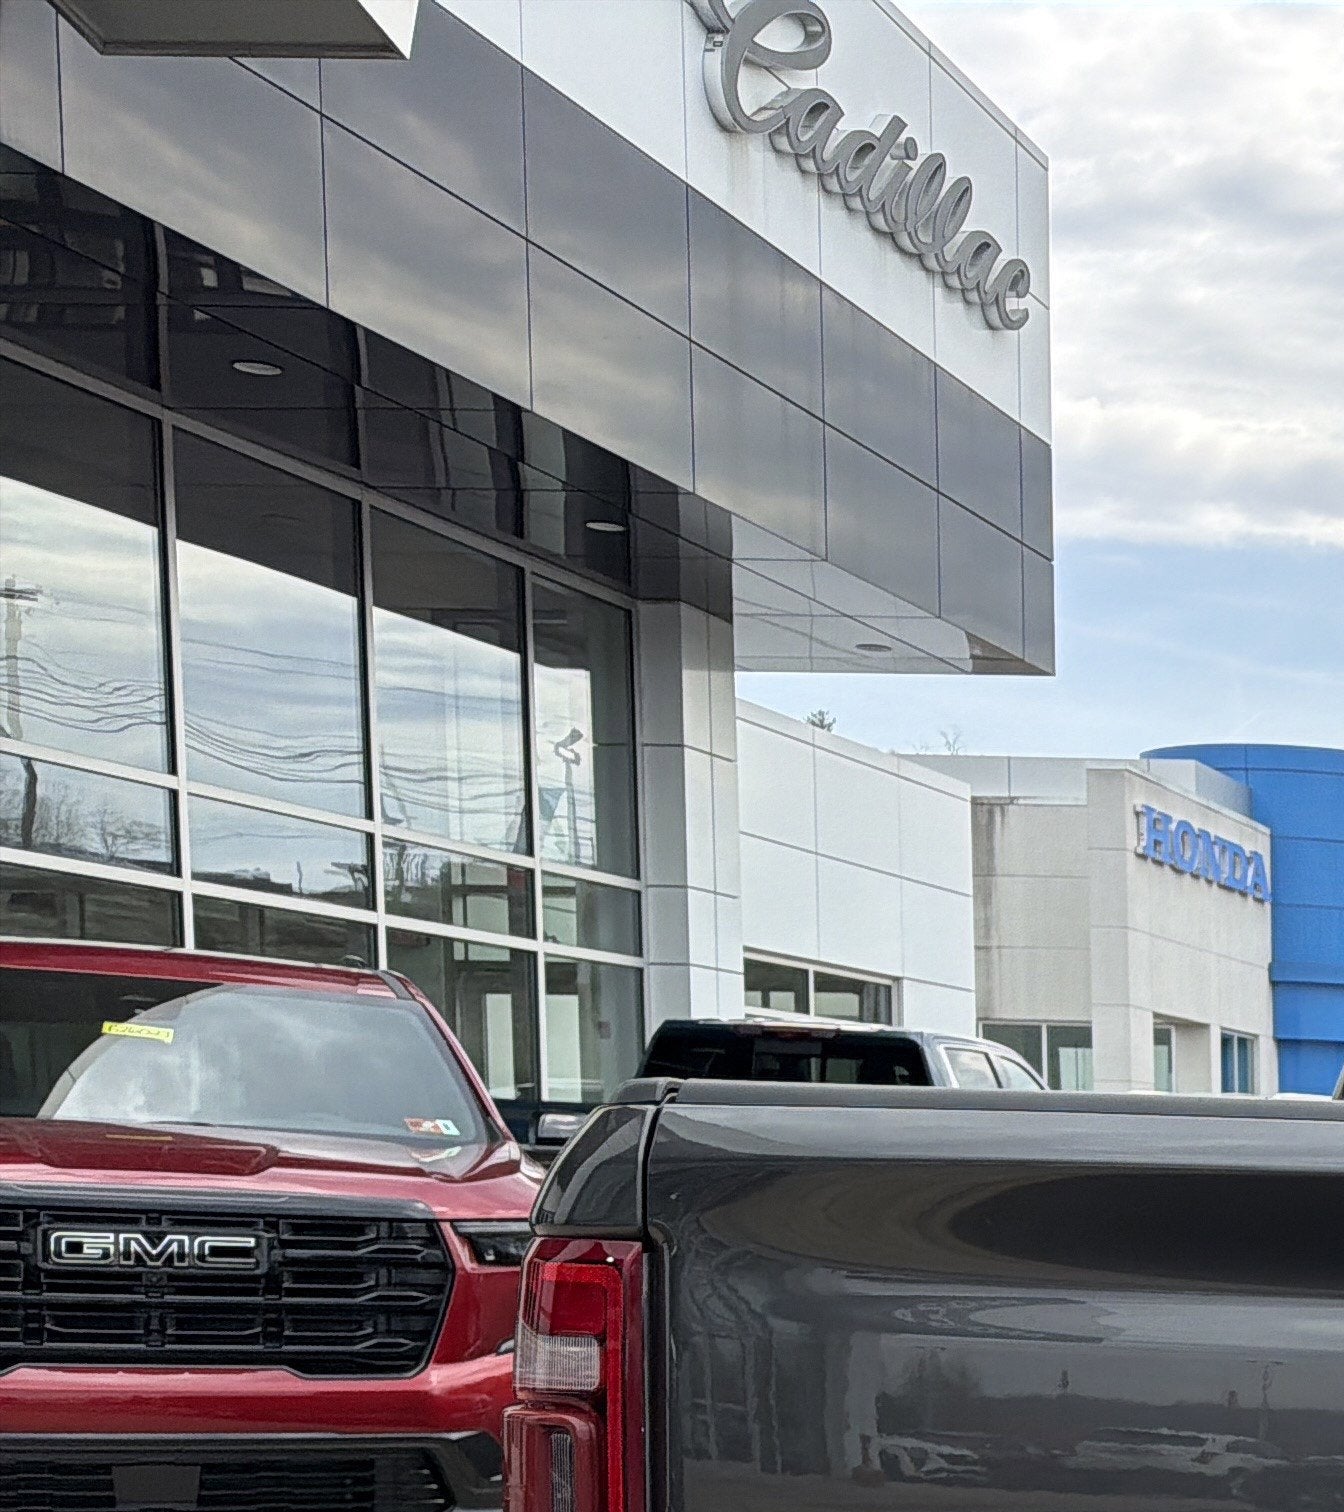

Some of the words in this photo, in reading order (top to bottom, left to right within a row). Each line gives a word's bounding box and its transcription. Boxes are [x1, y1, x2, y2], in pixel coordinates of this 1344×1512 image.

[684, 0, 1031, 331] Cadillac
[1136, 804, 1271, 902] HONDA
[50, 1231, 257, 1267] GMC
